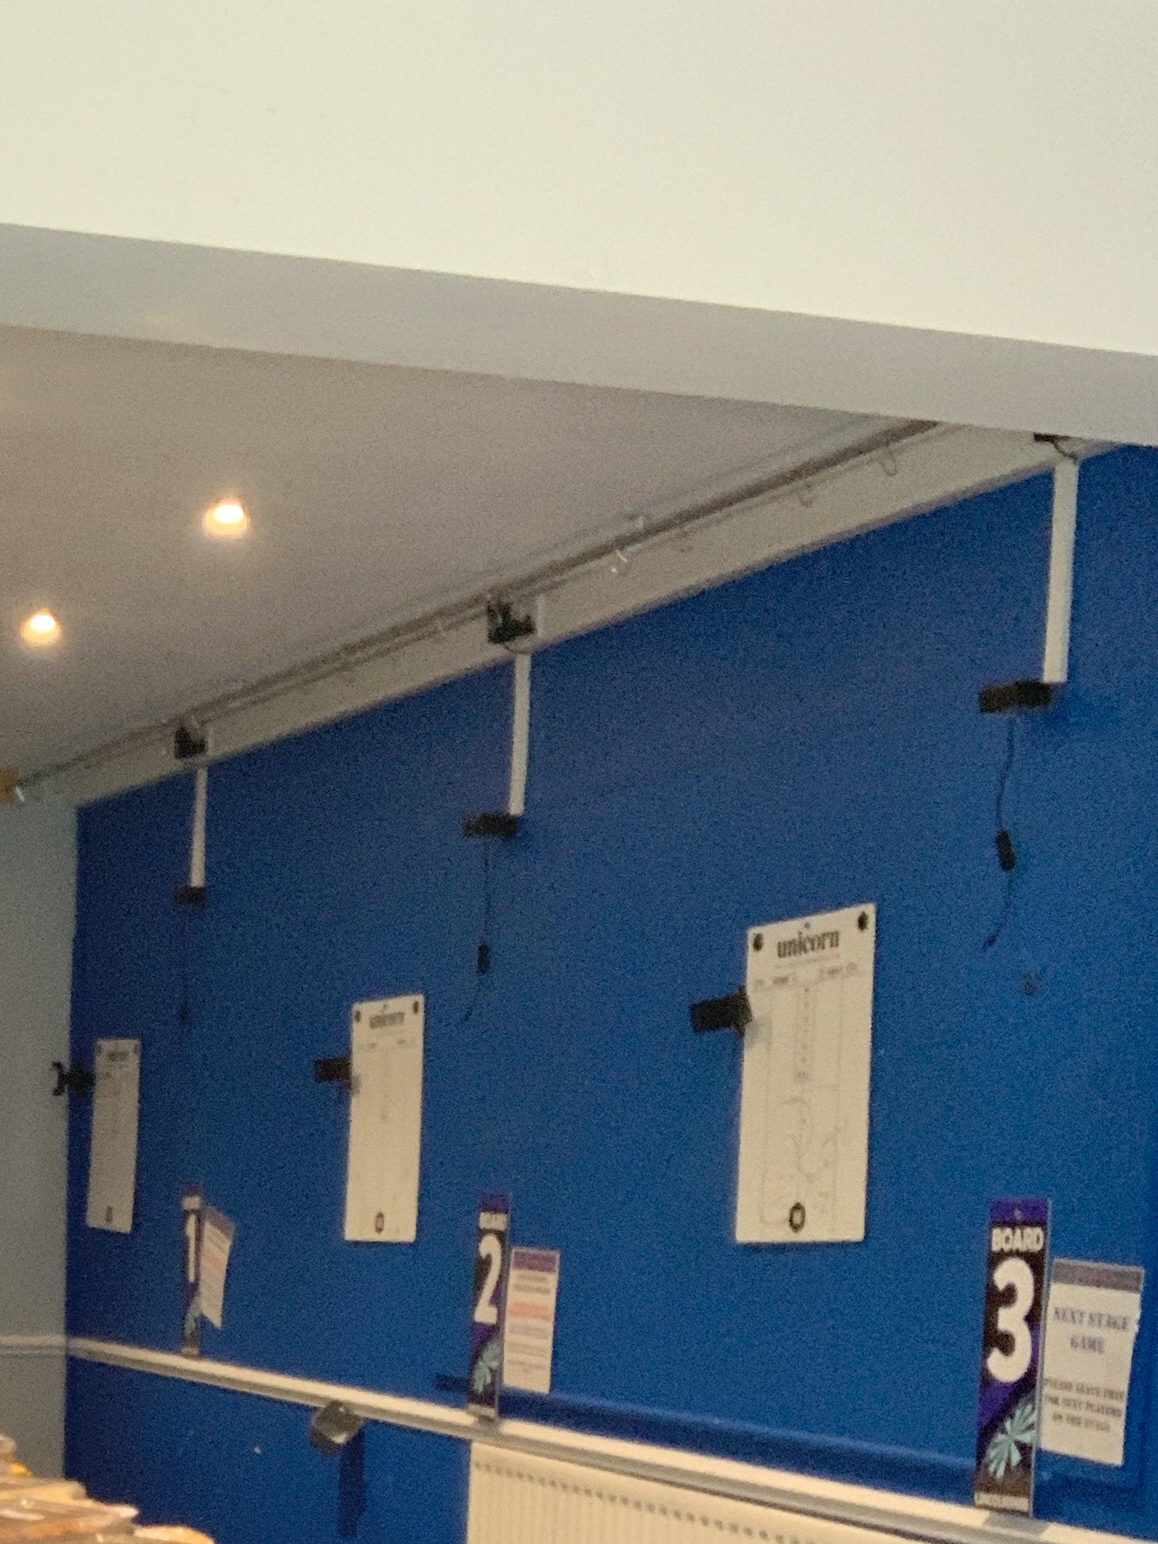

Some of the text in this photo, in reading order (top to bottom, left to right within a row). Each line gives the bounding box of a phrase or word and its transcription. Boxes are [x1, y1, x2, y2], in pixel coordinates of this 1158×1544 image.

[776, 930, 840, 958] unicorn
[992, 1226, 1044, 1253] BOARD
[474, 1233, 502, 1324] 2
[986, 1256, 1035, 1383] 3
